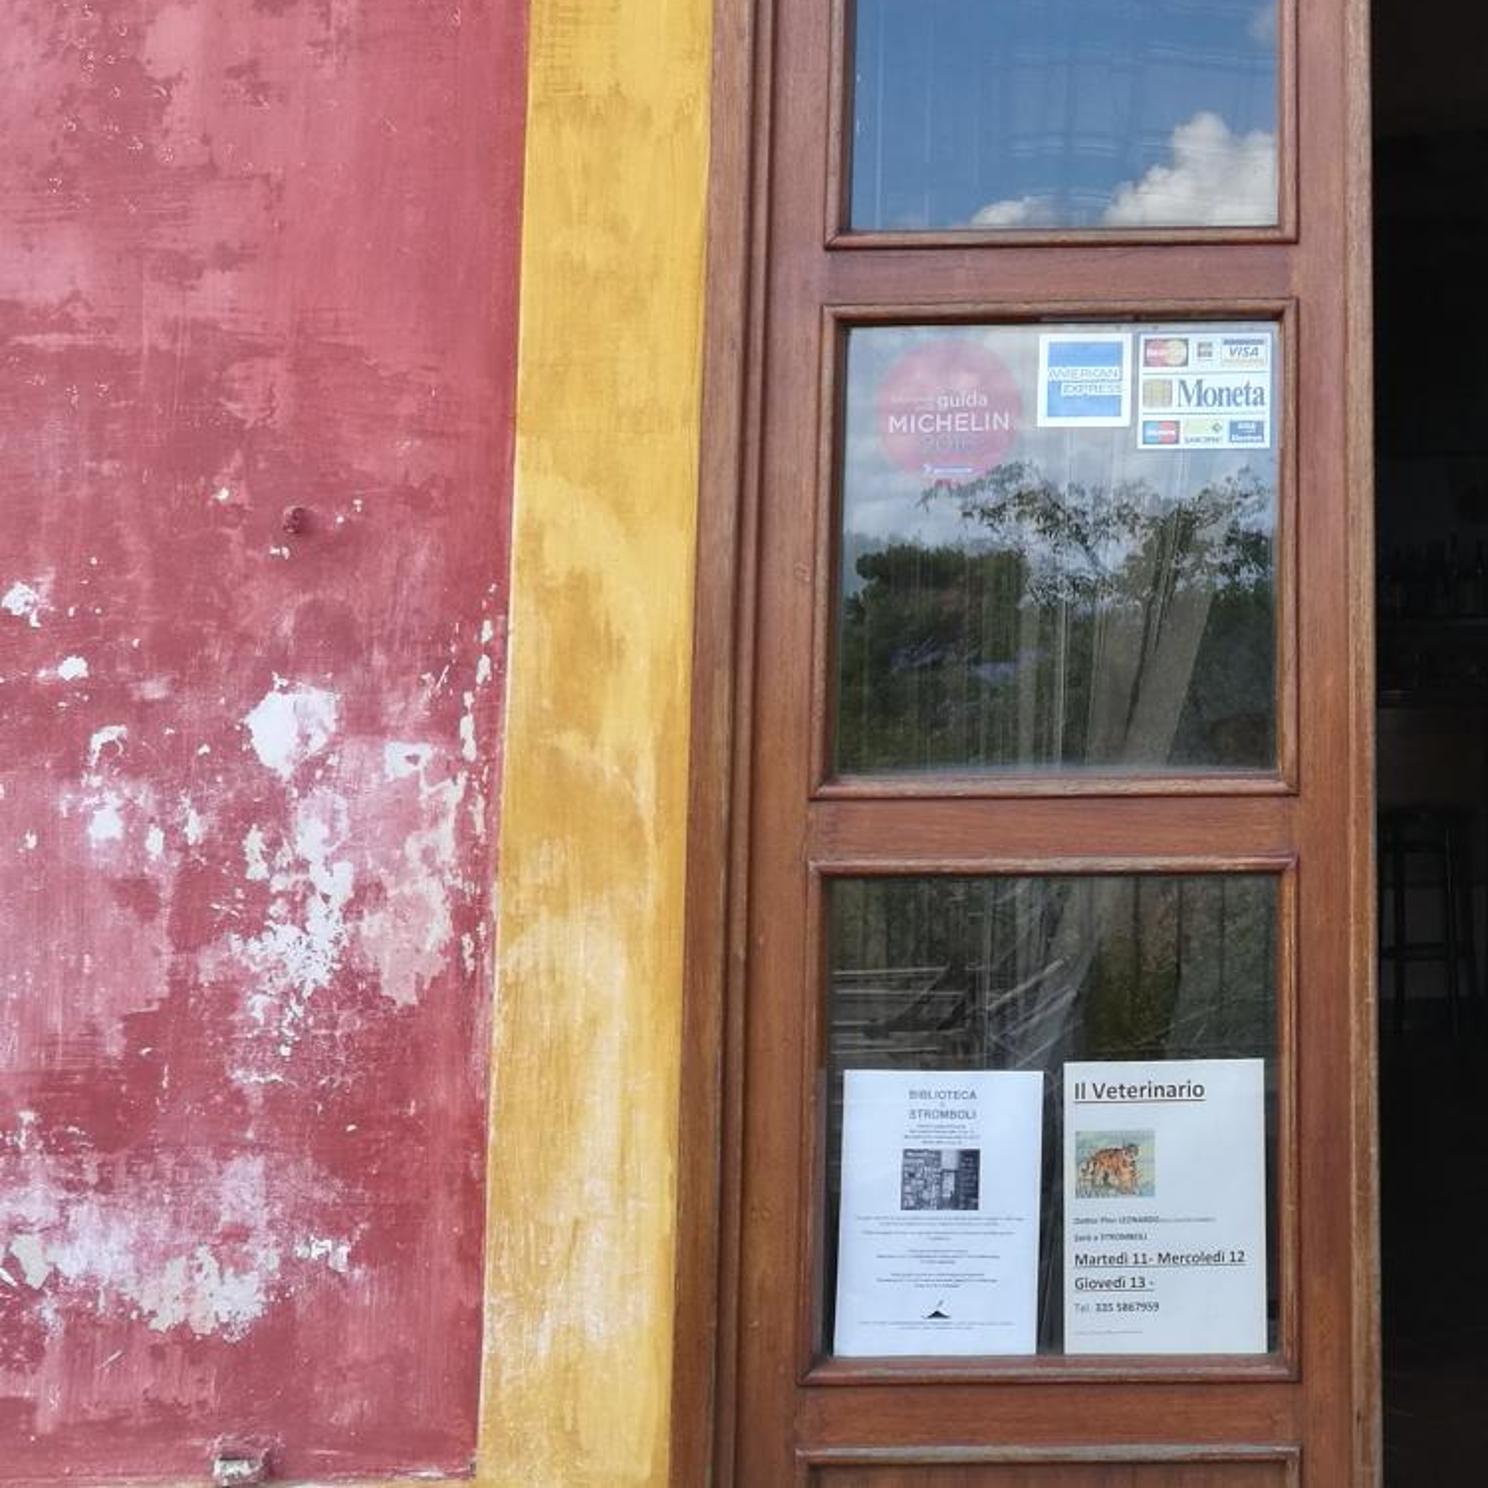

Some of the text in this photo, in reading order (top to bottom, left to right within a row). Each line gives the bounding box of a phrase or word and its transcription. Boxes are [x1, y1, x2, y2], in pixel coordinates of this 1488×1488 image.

[1229, 346, 1260, 358] VISA
[1048, 367, 1120, 381] AMERICAN
[936, 391, 988, 410] guida
[1177, 378, 1266, 408] Moneta
[888, 411, 1010, 434] MICHELIN
[1074, 1080, 1206, 1099] Il Veterinario
[1230, 1250, 1245, 1263] 12
[1131, 1277, 1146, 1288] 13
